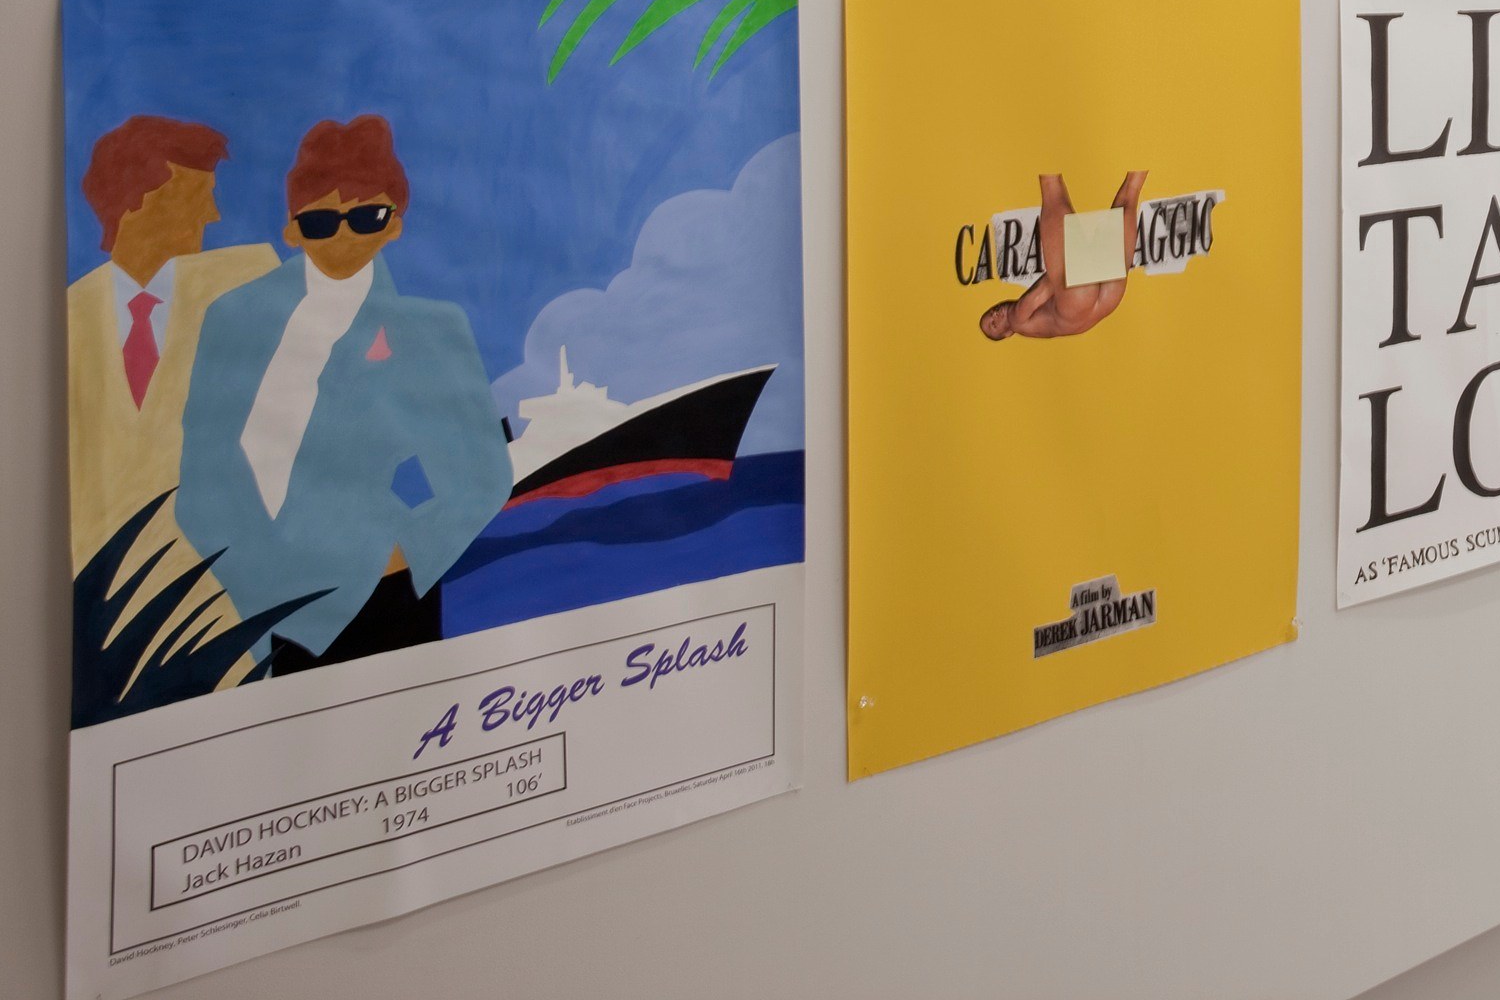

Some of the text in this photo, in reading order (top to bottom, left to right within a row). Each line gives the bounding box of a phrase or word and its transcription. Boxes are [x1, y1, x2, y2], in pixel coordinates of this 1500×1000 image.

[1072, 585, 1112, 607] A film by
[1355, 559, 1378, 585] AS
[1035, 591, 1155, 648] DEREK JARMAN
[412, 622, 747, 759] A Bigger Splash
[183, 748, 542, 864] DAVID HOCKNEY: A BIGGER SPLASH
[624, 801, 636, 810] Face
[693, 778, 718, 788] Saturday
[181, 863, 229, 894] Jack
[236, 844, 301, 875] Hazan
[382, 807, 429, 834] 1974
[109, 953, 134, 966] David
[136, 942, 176, 957] Hockney,
[178, 935, 198, 945] Peter
[250, 911, 268, 921] Celia
